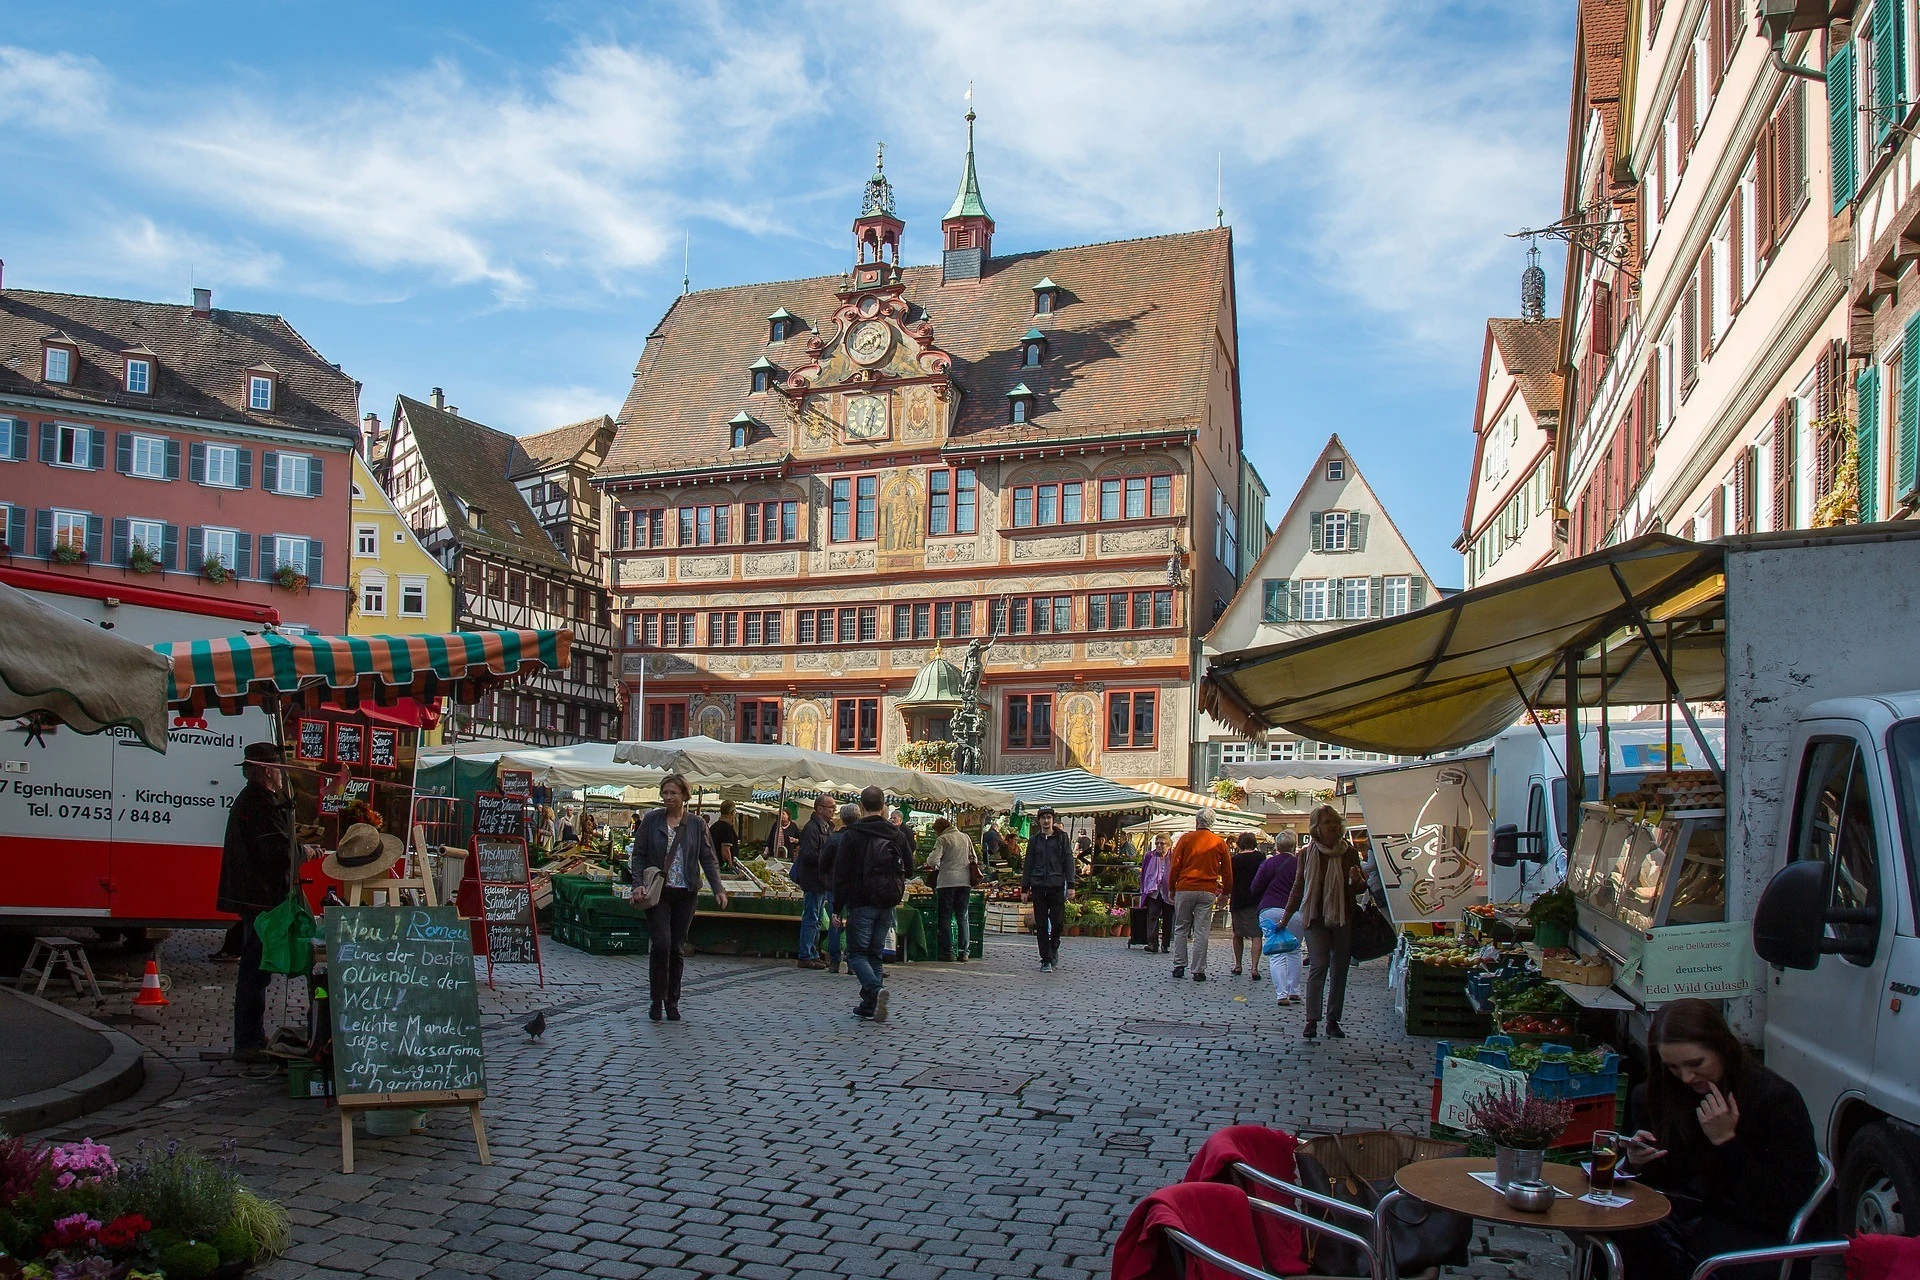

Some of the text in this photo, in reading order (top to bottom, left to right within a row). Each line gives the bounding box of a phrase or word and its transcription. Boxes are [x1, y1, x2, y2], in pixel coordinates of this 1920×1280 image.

[168, 732, 234, 748] warzwald
[14, 781, 112, 800] Egenhausen
[136, 789, 216, 808] Kirchgasse
[27, 803, 53, 817] Tel.
[59, 805, 112, 821] 07453
[130, 809, 171, 824] 8484
[478, 810, 499, 827] Hals
[338, 942, 470, 967] Eines der besten
[1667, 941, 1731, 952] eine Delikatesse
[1676, 964, 1723, 974] deutsches
[437, 972, 470, 990] der
[1646, 979, 1749, 995] Edel Wild Gulasch
[398, 1036, 483, 1058] Nussaroma
[344, 1058, 457, 1079] sehr elegant
[1473, 1078, 1500, 1090] Premium
